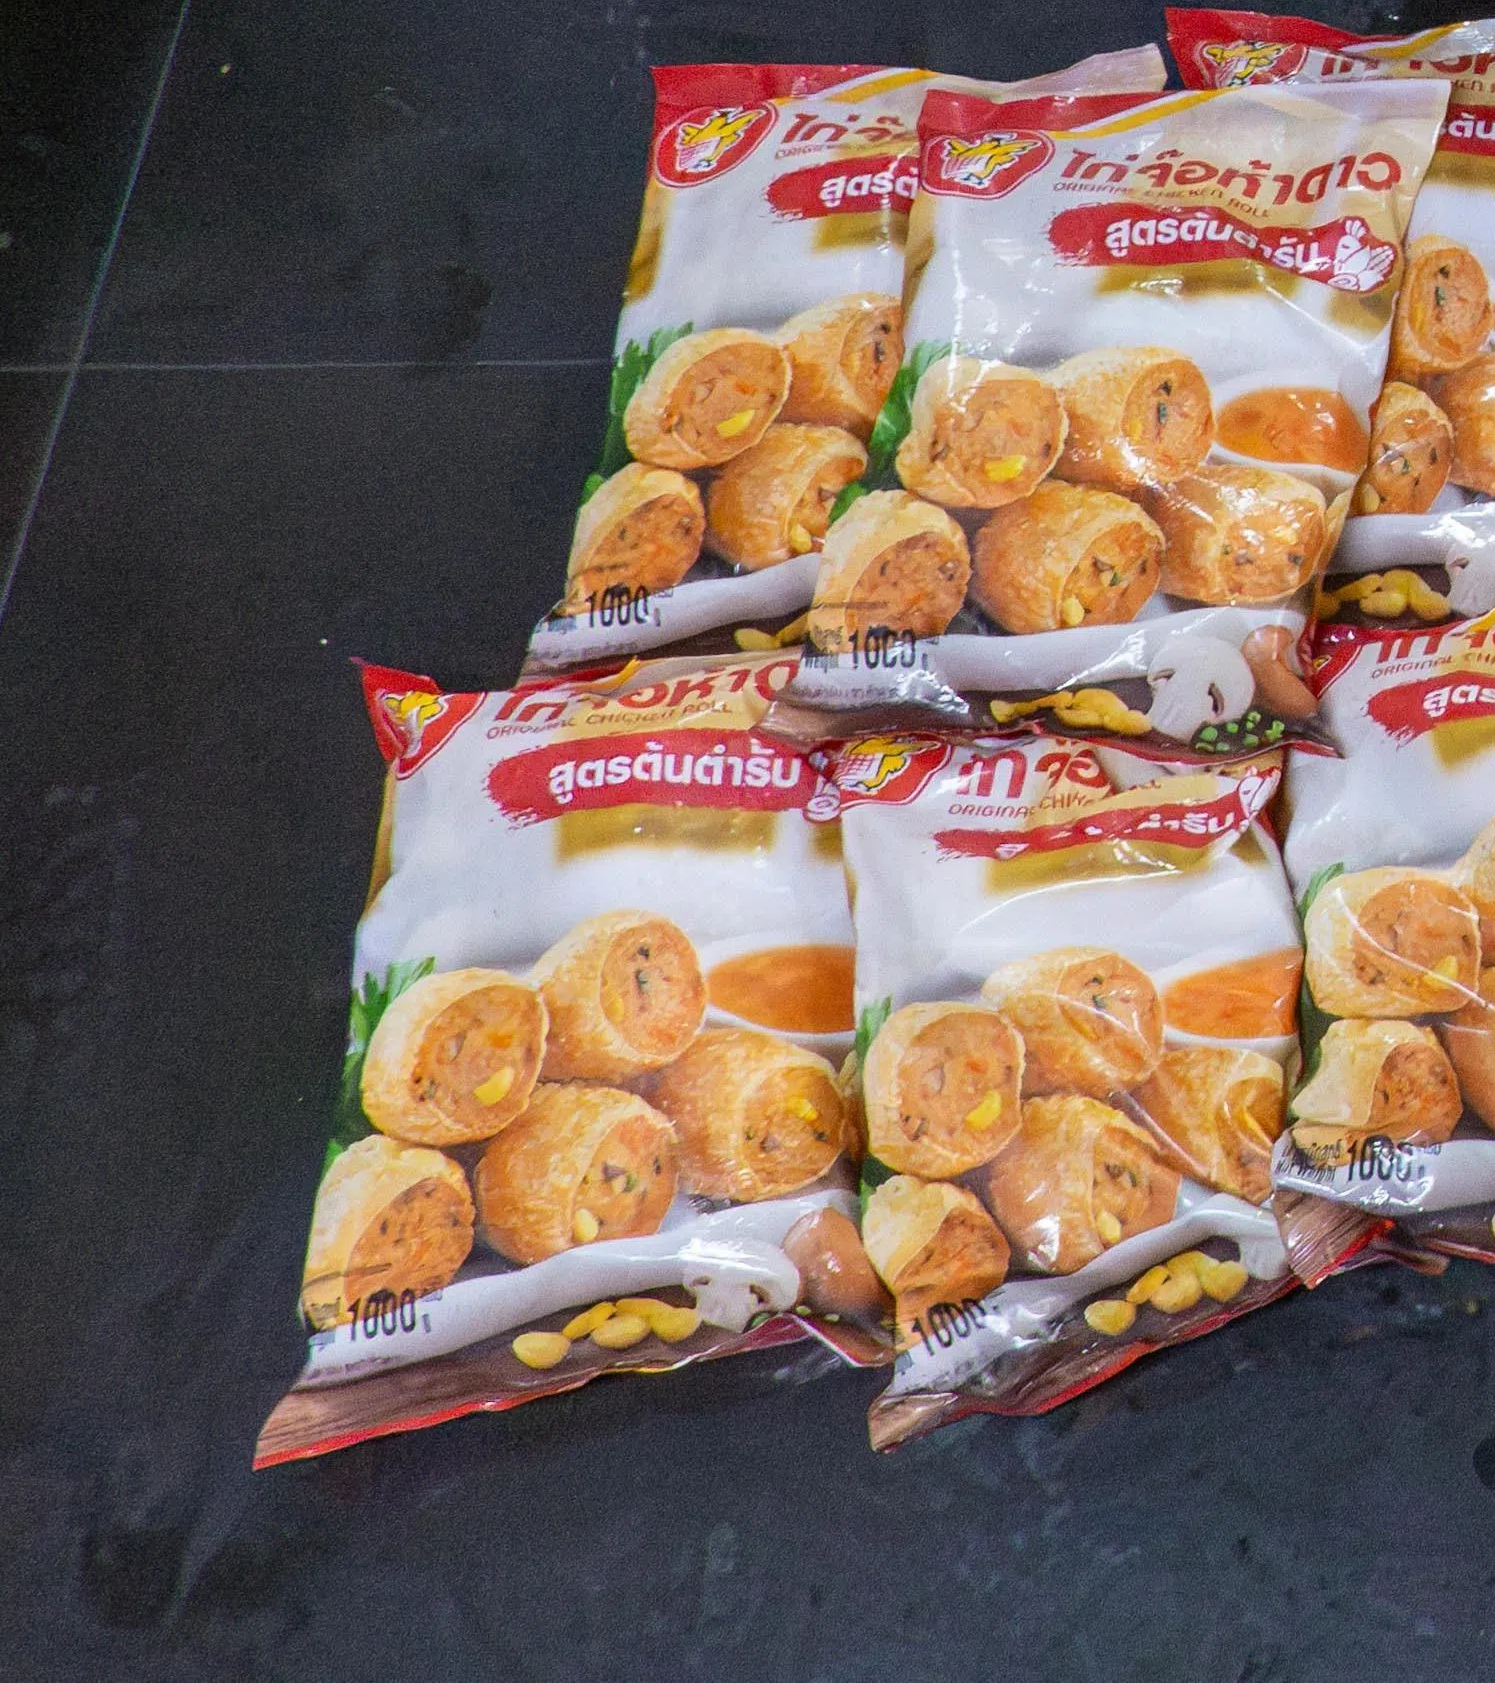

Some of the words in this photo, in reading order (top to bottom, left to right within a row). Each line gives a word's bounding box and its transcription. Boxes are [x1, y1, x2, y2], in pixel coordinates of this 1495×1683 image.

[1061, 148, 1402, 206] ไก่จ๊อห้าดาว
[1227, 197, 1271, 219] ROLL
[585, 583, 649, 628] 1000
[1371, 656, 1454, 679] ORIGINAL
[549, 737, 801, 805] สูตรต้นตำรับ
[348, 1288, 417, 1342] 1000
[911, 1297, 987, 1356] 1000
